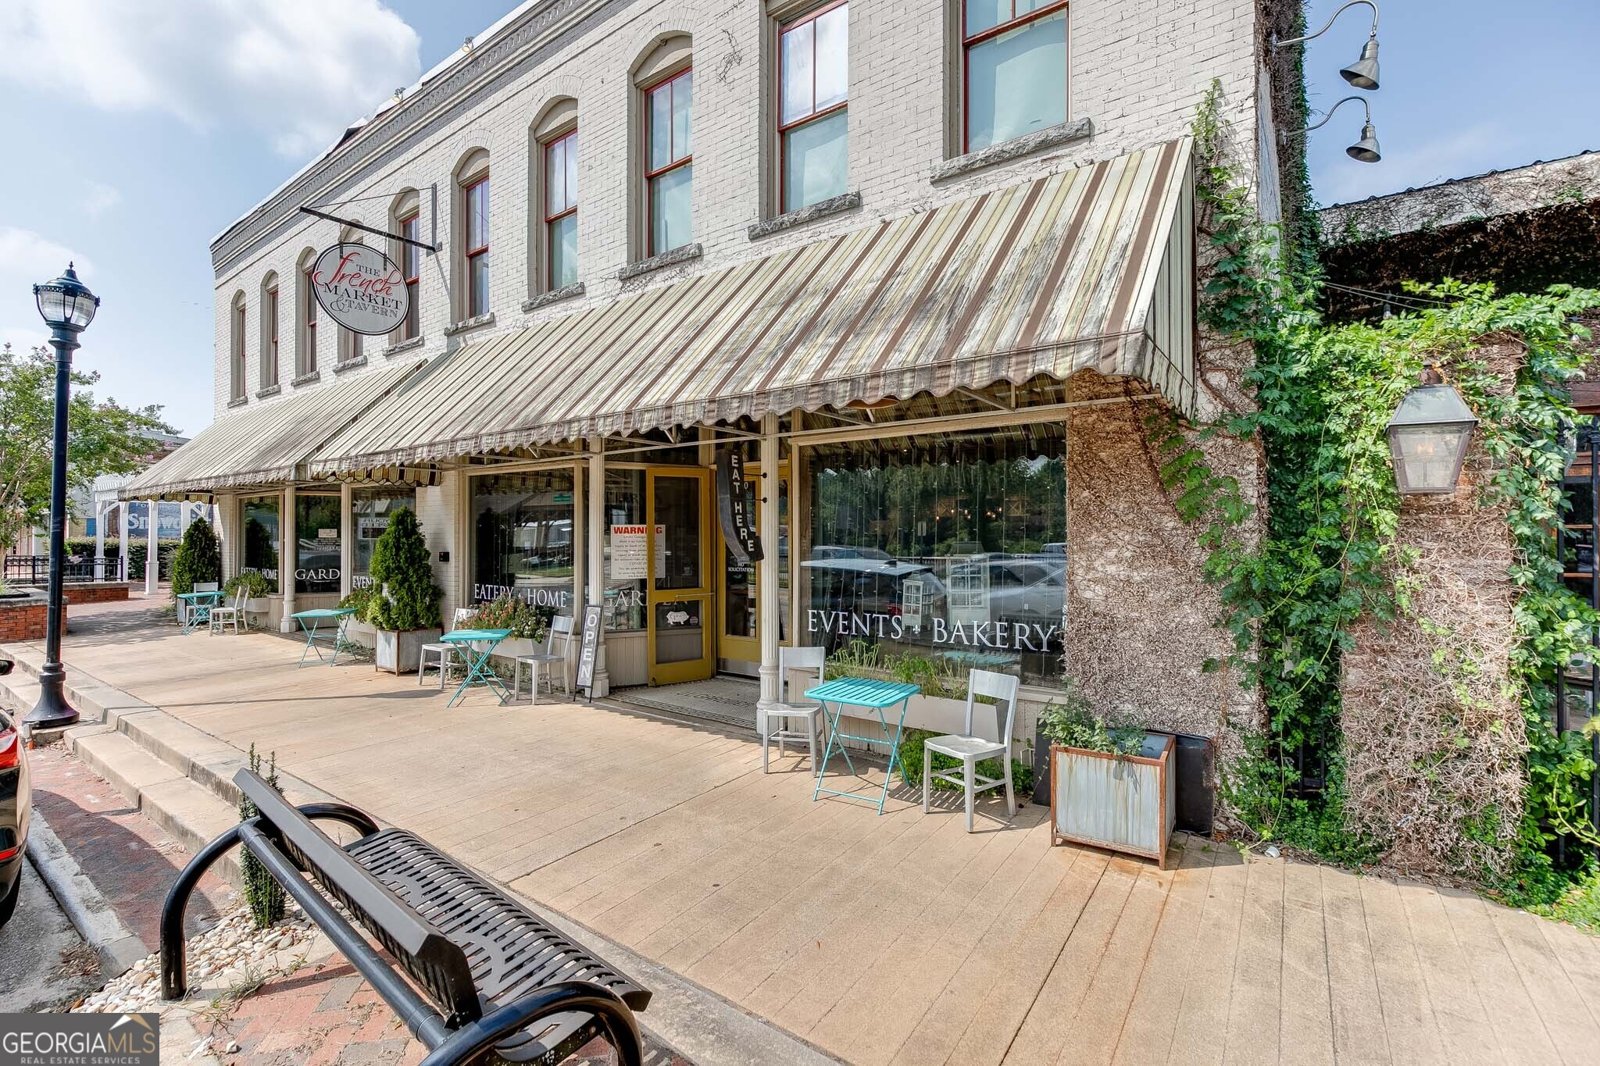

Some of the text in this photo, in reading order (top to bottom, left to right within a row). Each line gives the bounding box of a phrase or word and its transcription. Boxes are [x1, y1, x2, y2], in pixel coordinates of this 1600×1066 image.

[356, 264, 380, 277] THE
[323, 282, 403, 310] MARKET
[346, 299, 399, 318] TAVERN
[731, 454, 755, 552] EAT HERE
[613, 526, 663, 534] WARNIG
[527, 588, 567, 608] HOME
[807, 609, 1057, 652] EVENTS BAKERY
[580, 614, 598, 679] OPEN
